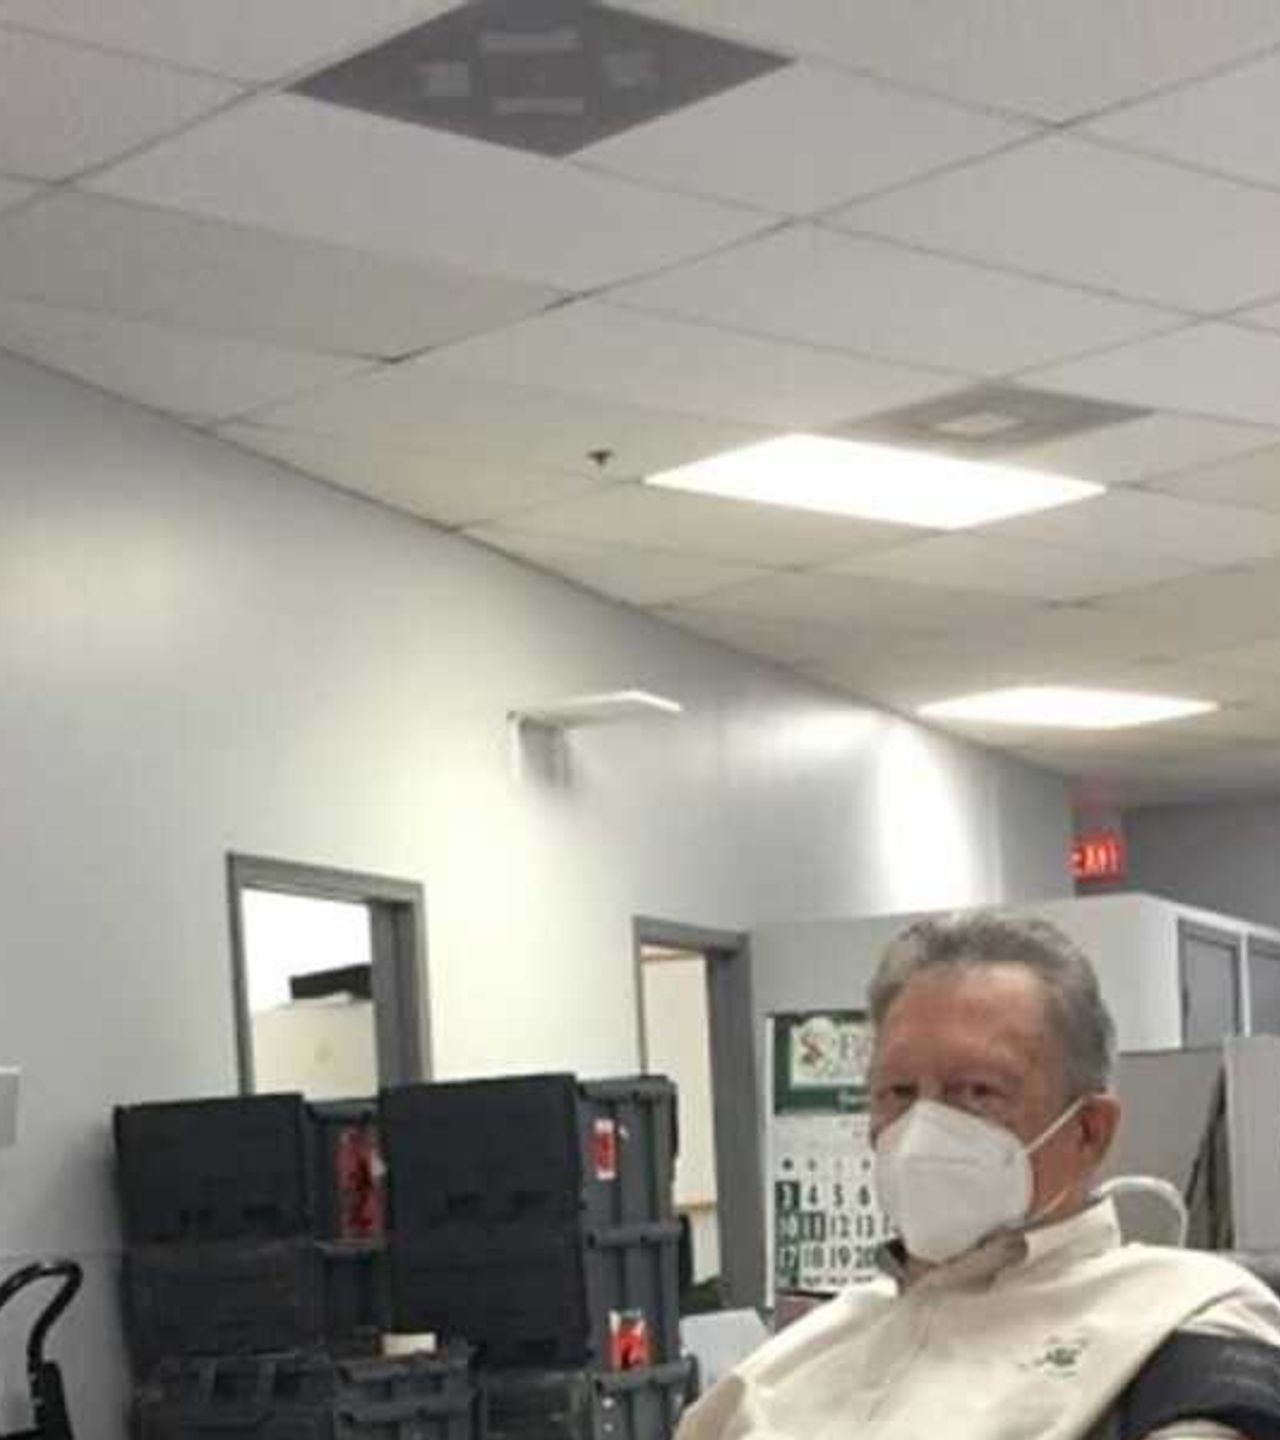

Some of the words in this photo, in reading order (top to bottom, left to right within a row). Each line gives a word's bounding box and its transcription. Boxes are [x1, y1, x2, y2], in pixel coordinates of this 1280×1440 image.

[830, 1214, 850, 1239] 12
[856, 1213, 875, 1238] 13
[830, 1246, 851, 1269] 19
